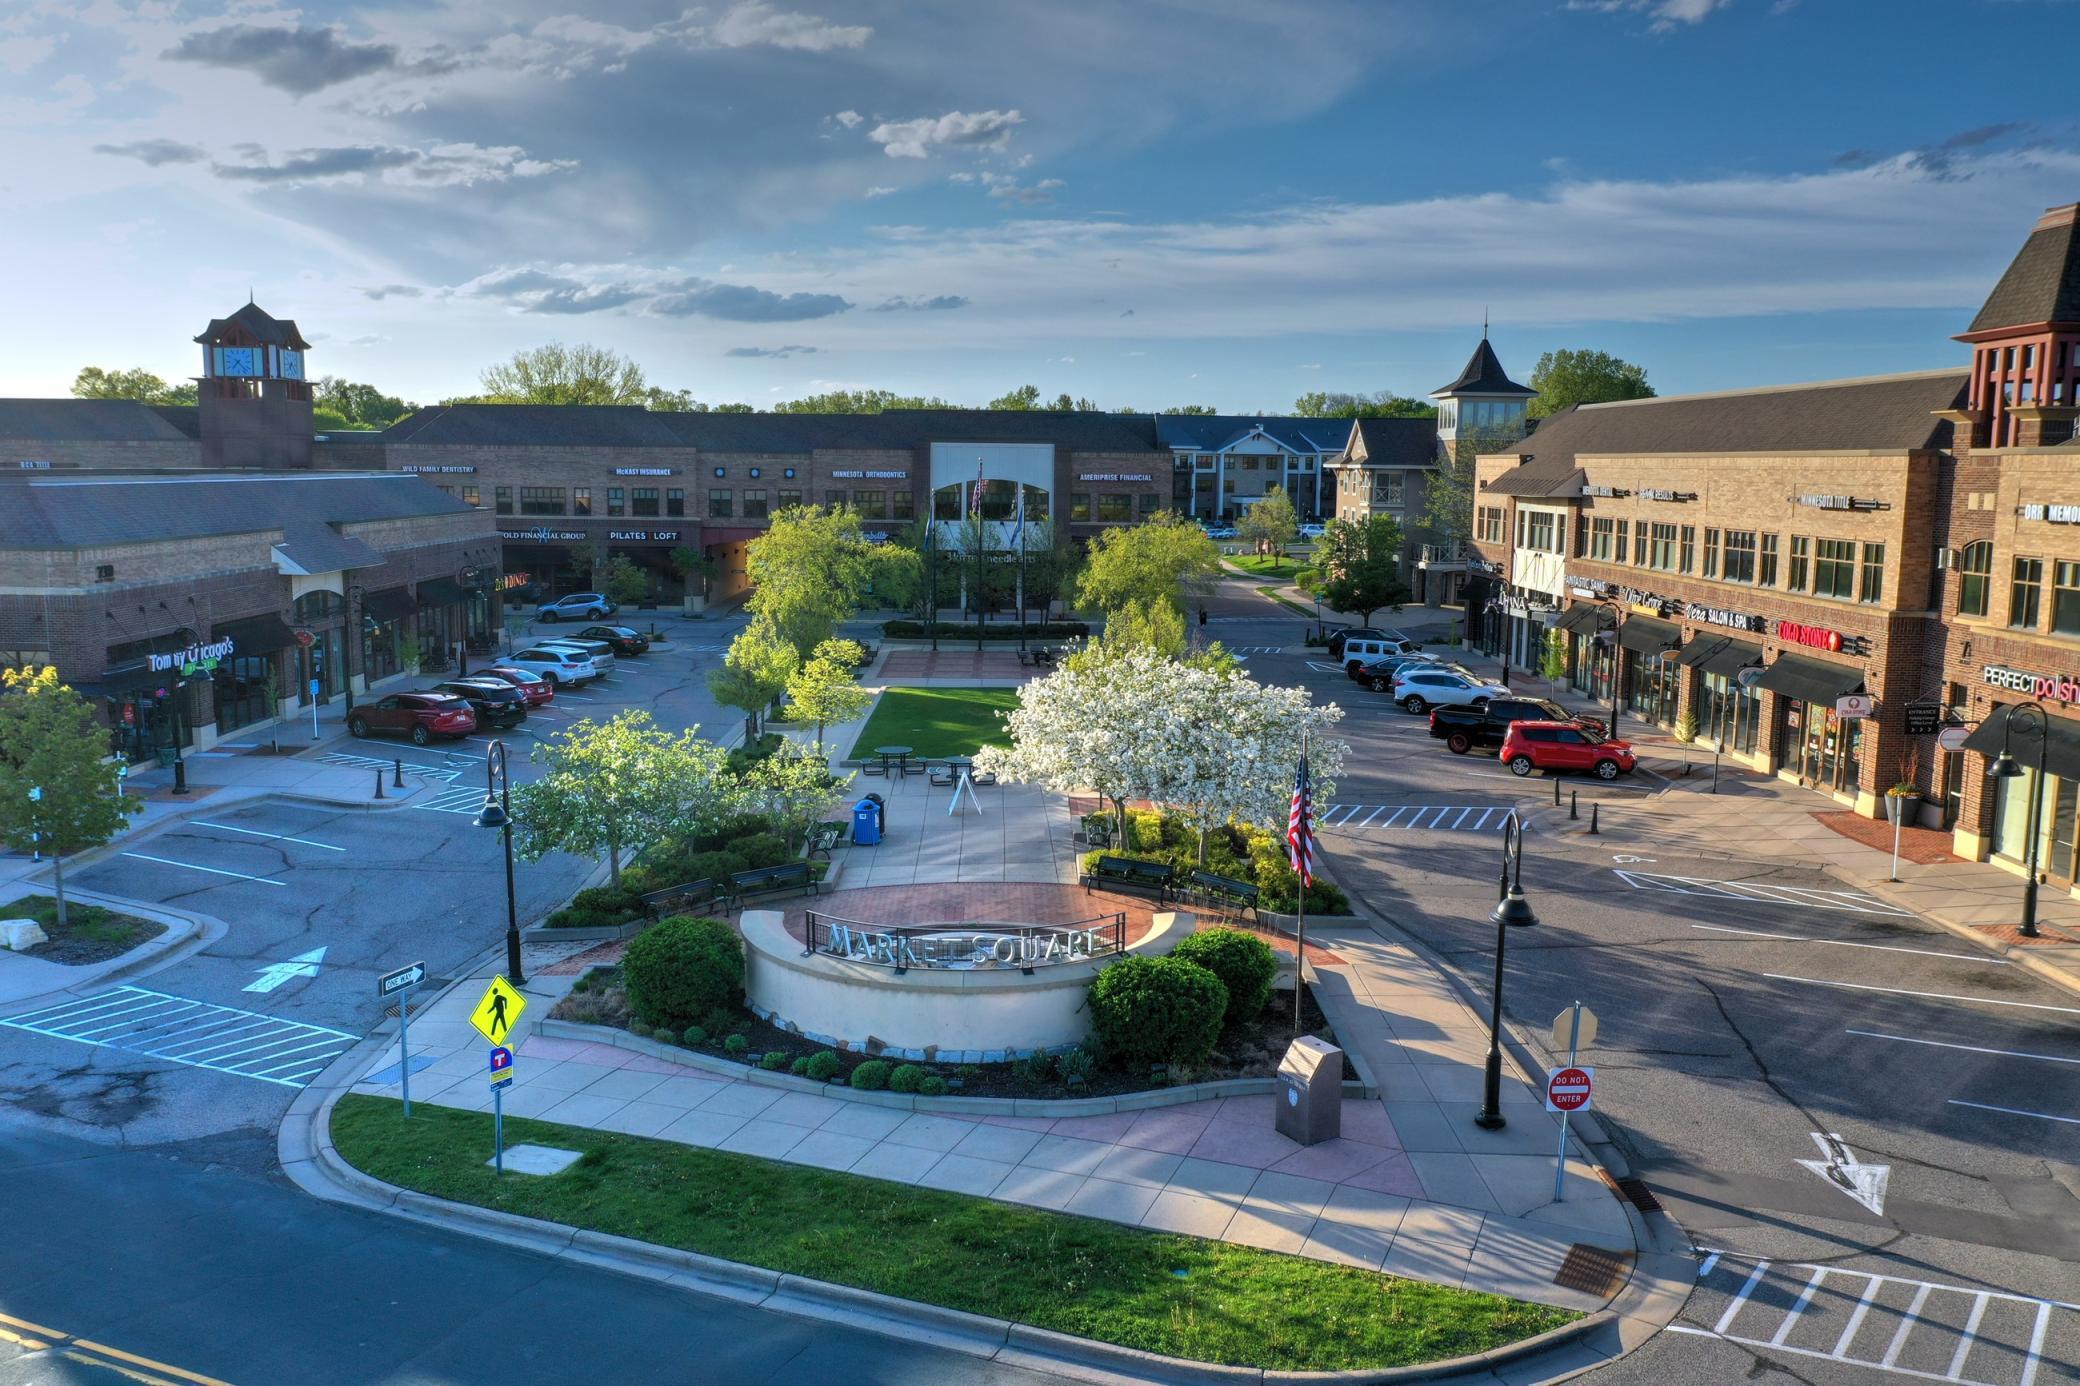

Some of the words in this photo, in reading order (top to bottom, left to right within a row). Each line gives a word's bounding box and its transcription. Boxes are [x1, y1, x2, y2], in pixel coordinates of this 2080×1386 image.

[441, 465, 474, 473] DENTISTRY
[640, 468, 671, 476] INSURANCE
[832, 470, 864, 478] MINNESOTA
[865, 471, 907, 479] ORTHODONTICS
[1080, 473, 1119, 481] AMERIPRISE
[1120, 473, 1153, 481] FINANCIAL
[1801, 493, 1834, 508] MINNESOTA
[1834, 496, 1849, 508] TITLE
[2025, 504, 2044, 520] ORR
[2049, 504, 2080, 523] MEMO
[520, 532, 559, 540] FINANCIAL
[561, 532, 586, 540] GROUP
[610, 532, 646, 540] PILATES
[653, 532, 678, 540] LOFT
[1686, 603, 1707, 622] Vera
[1708, 608, 1729, 626] SALON
[1729, 612, 1734, 627] &
[1735, 614, 1747, 630] SPA
[1778, 621, 1799, 642] COLD
[1800, 626, 1830, 650] STONE
[829, 923, 962, 964] MARKET
[971, 926, 1104, 966] SQUARE
[387, 977, 399, 989] ONE
[400, 972, 412, 983] WAY
[495, 1053, 506, 1067] T
[1556, 1076, 1567, 1084] DO
[1570, 1076, 1586, 1084] NOT
[1557, 1095, 1581, 1103] ENTER
